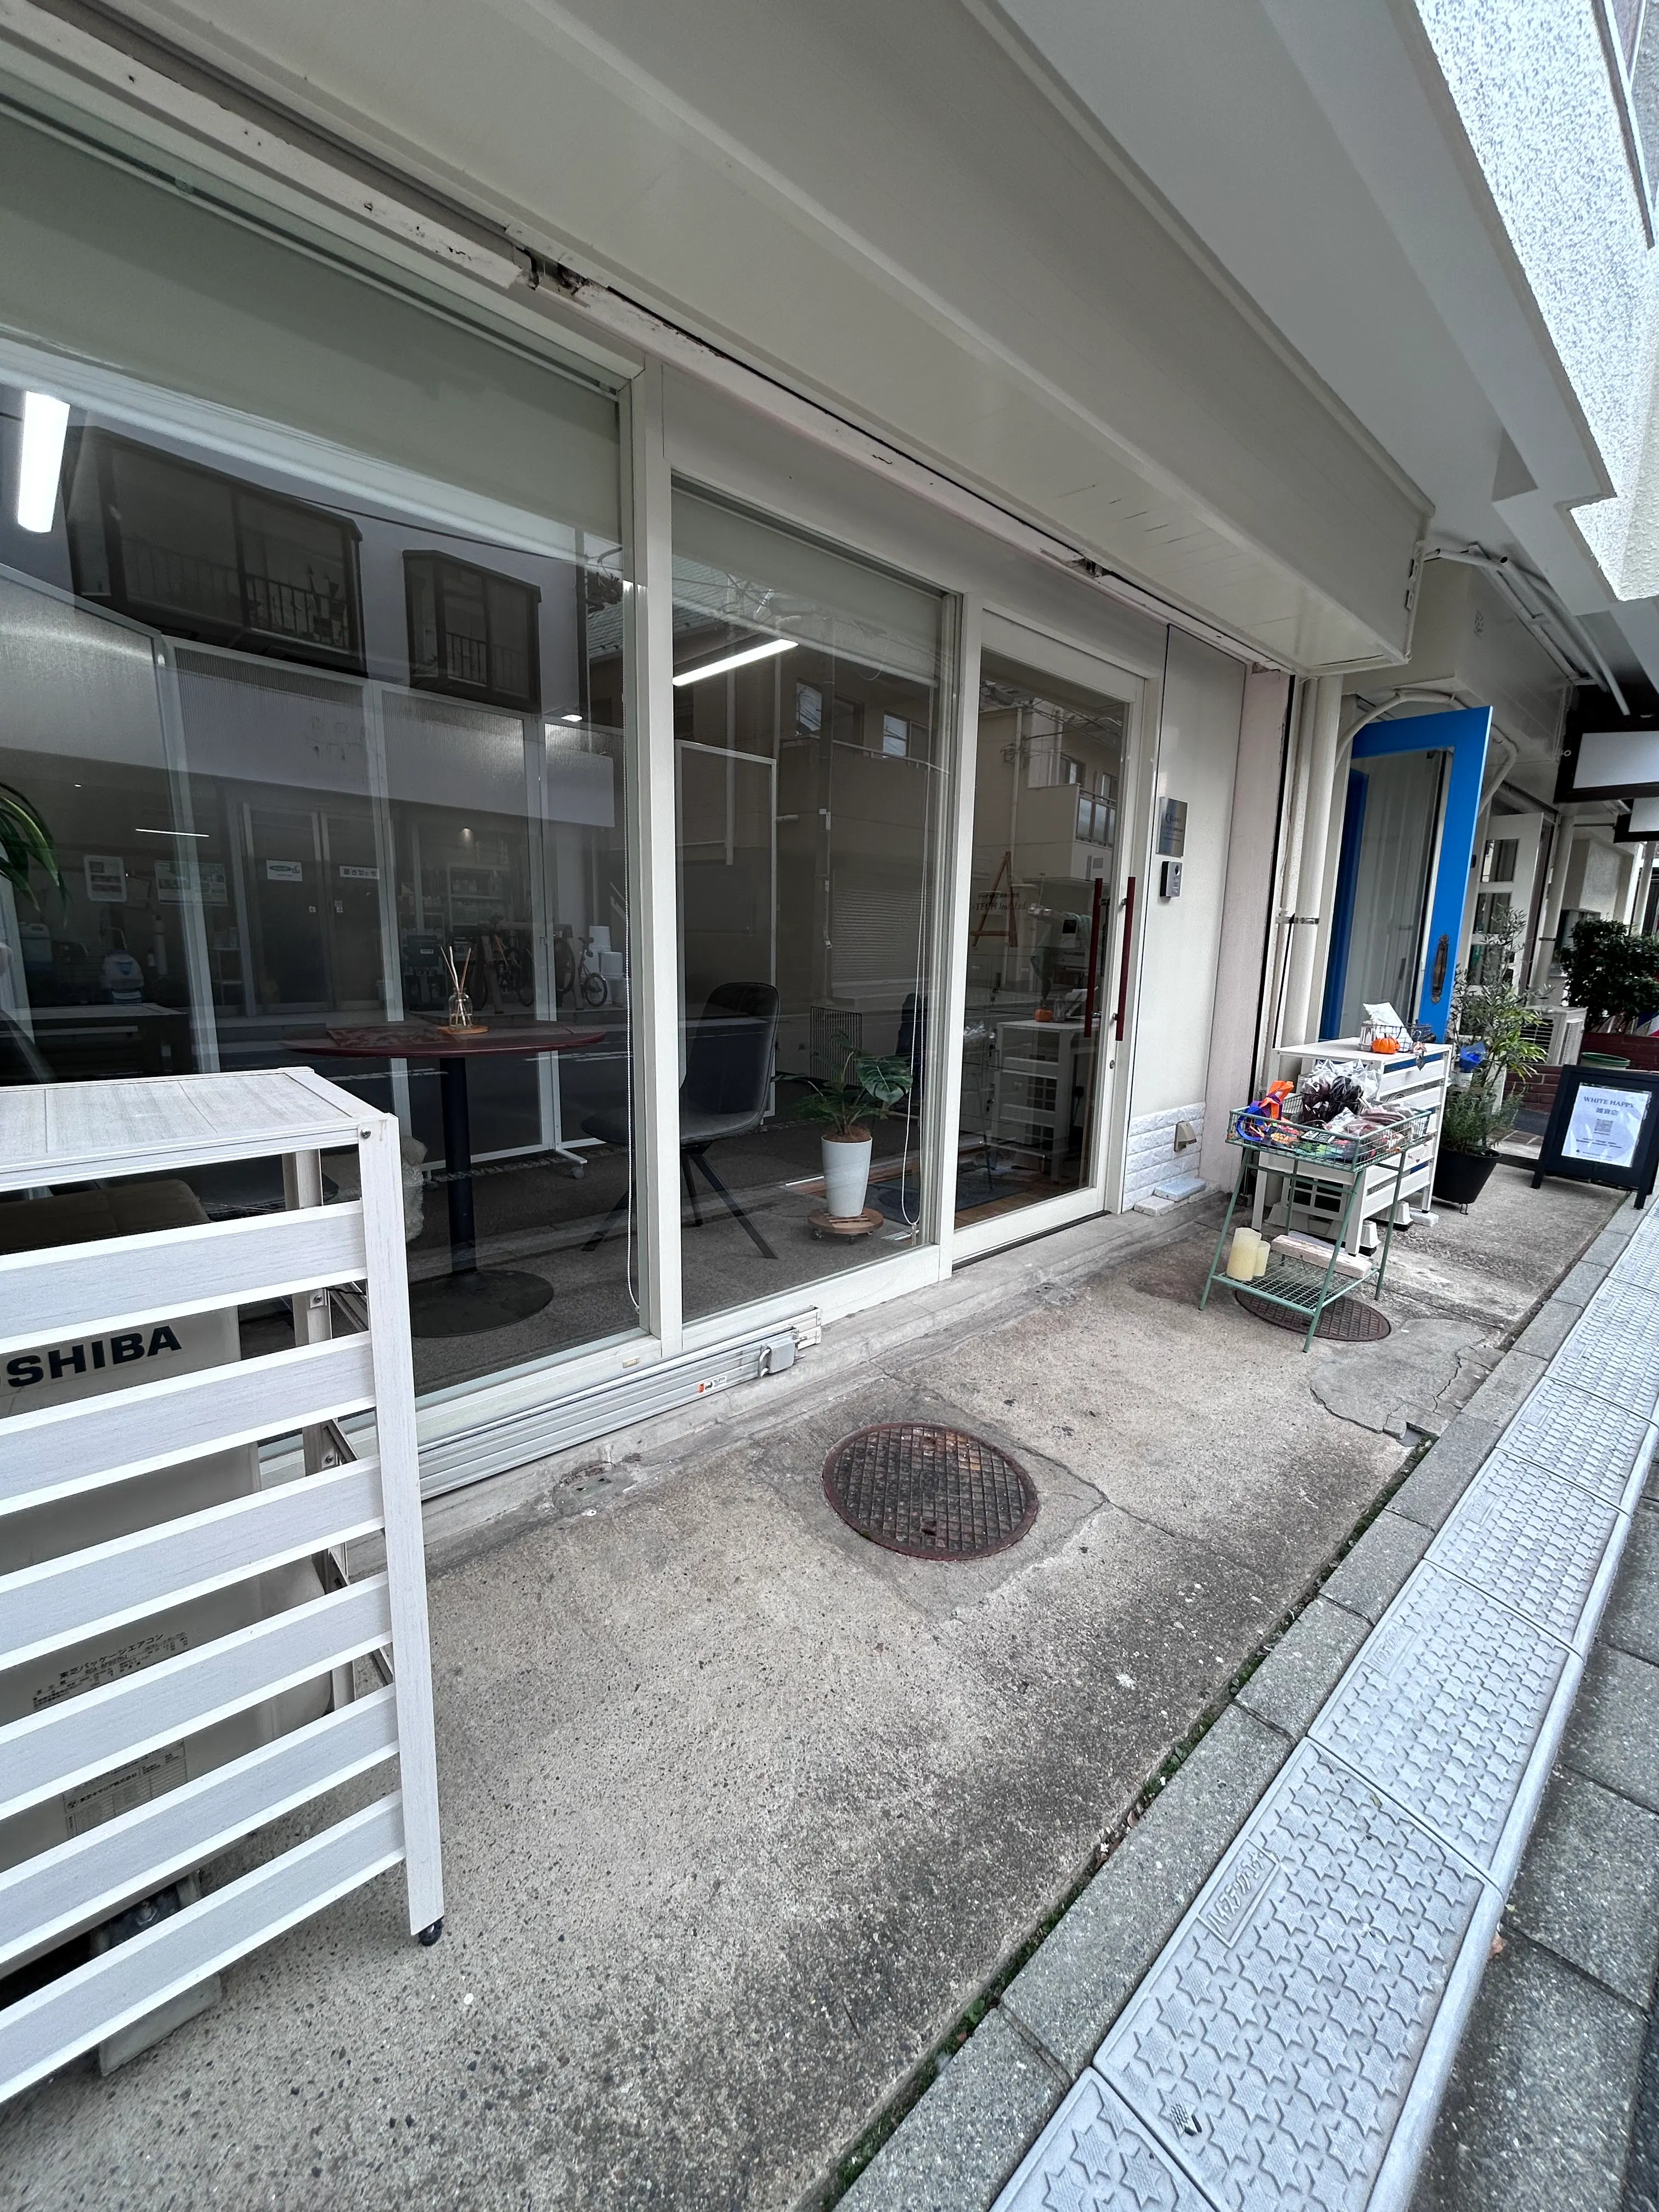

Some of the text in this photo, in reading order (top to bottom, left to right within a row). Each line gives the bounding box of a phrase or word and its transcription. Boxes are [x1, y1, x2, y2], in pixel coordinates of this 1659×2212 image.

[1584, 1096, 1635, 1108] WHITE HAPPY
[1596, 1107, 1619, 1116] 雑貨店
[0, 1325, 182, 1387] SHIBA
[59, 1634, 163, 1679] 東芝パッケージエアコン
